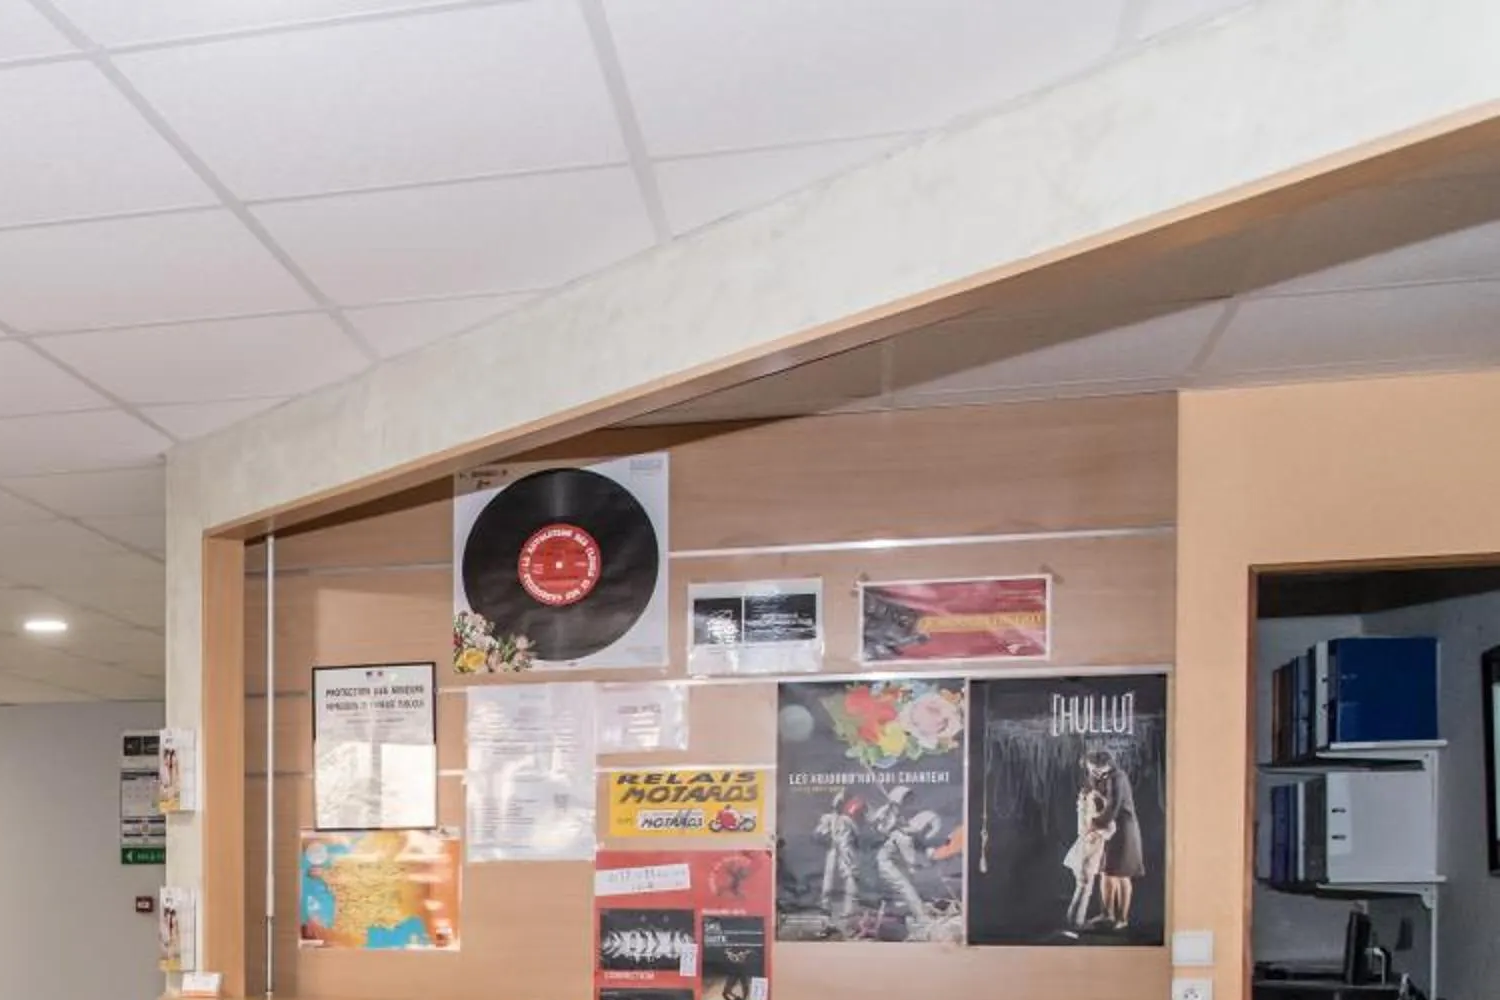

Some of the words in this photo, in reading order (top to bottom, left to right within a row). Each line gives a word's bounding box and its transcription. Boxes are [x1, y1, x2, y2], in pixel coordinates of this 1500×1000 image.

[616, 771, 757, 785] RELAIS
[899, 771, 949, 784] CHANTENT
[619, 785, 759, 804] MOTARDS
